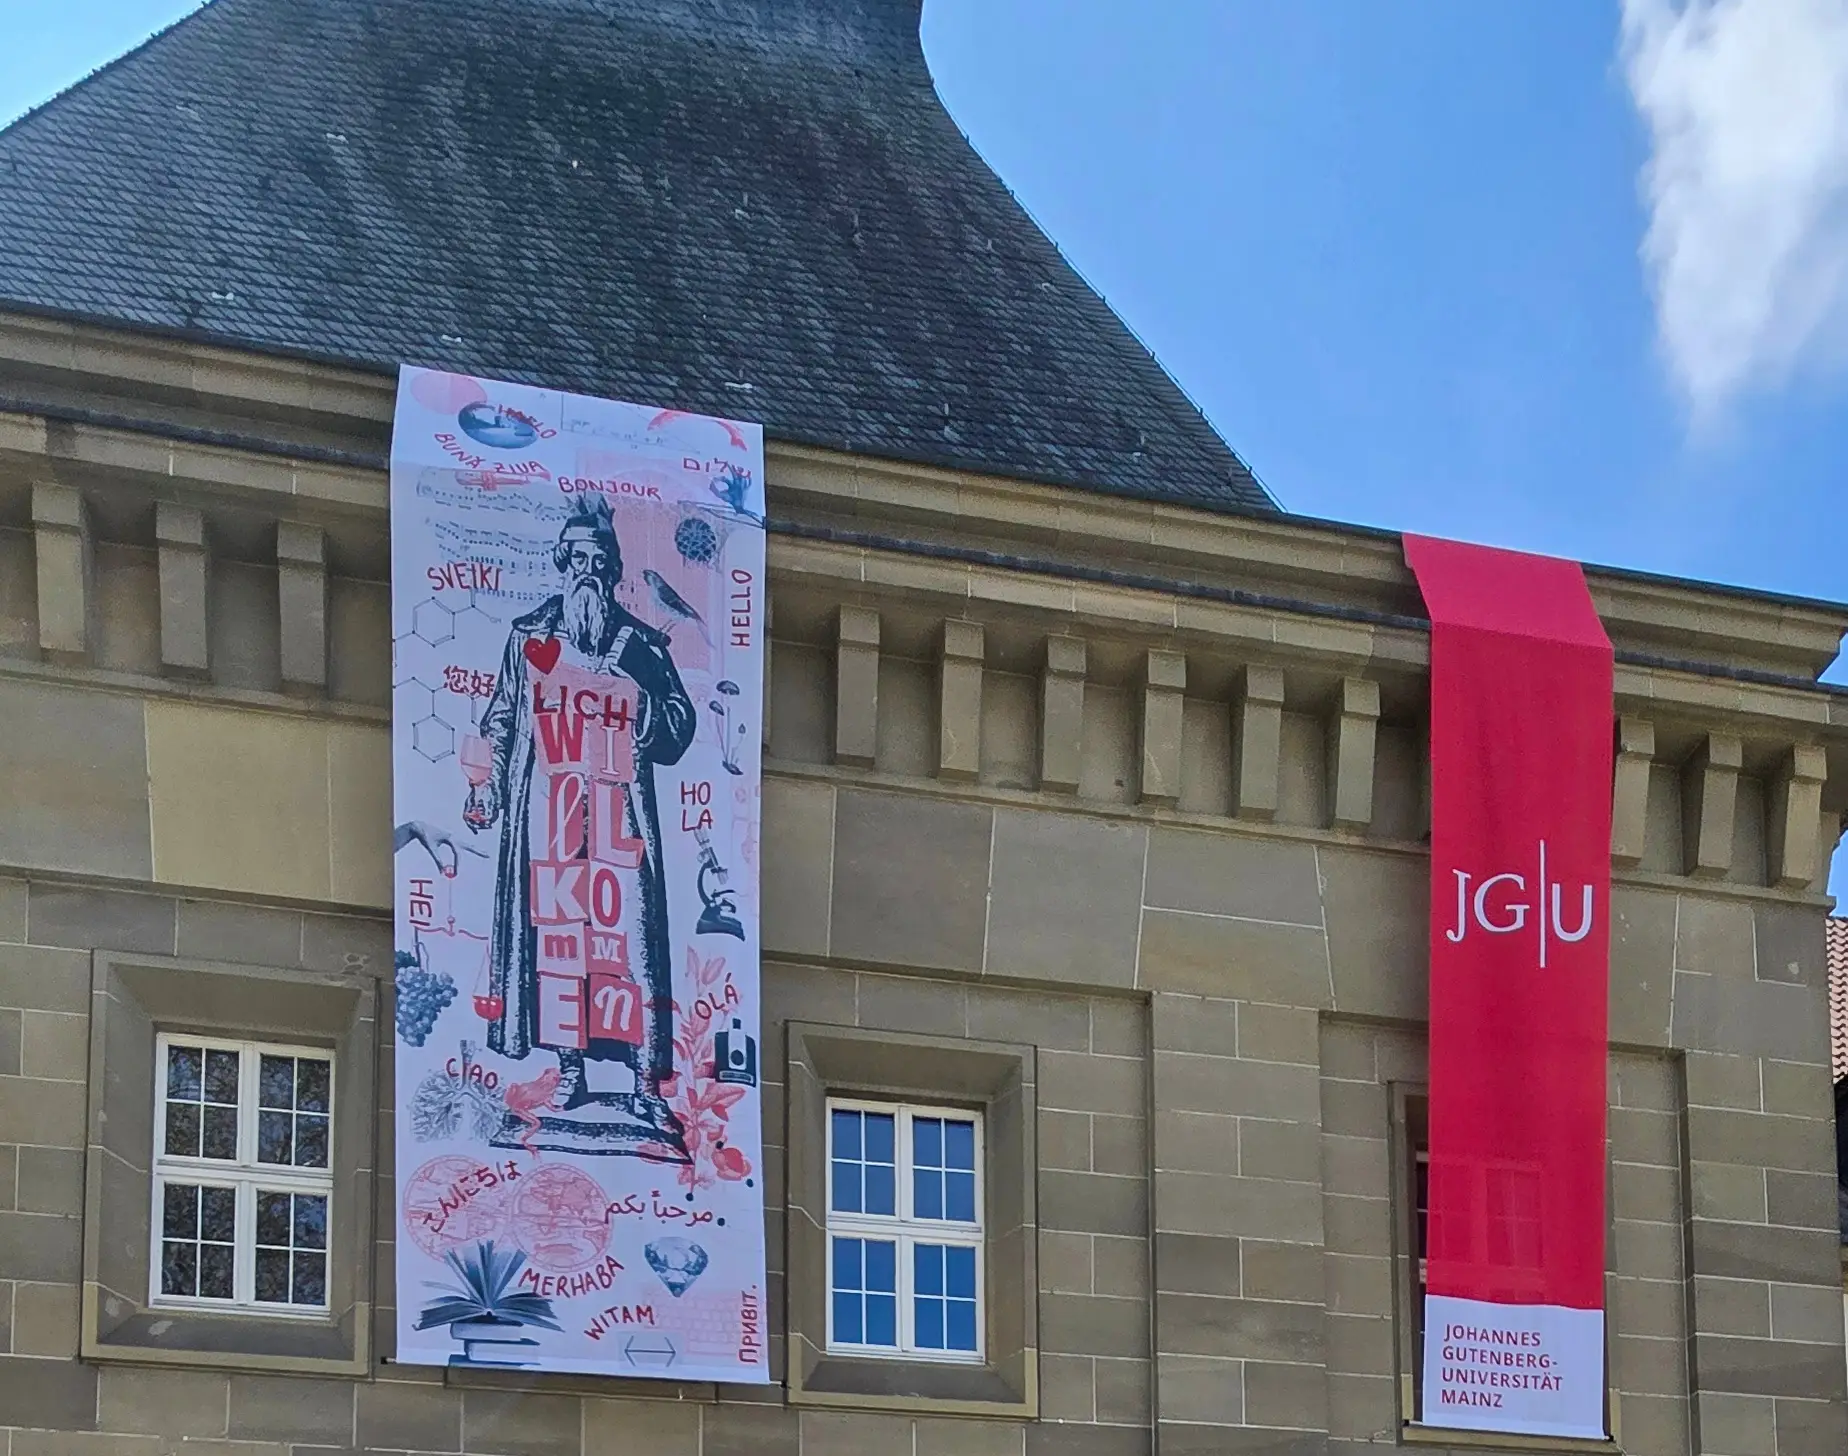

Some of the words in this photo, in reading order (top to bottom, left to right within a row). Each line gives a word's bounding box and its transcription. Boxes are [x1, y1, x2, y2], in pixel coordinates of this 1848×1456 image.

[557, 475, 662, 500] BONJOUR
[426, 562, 503, 591] SVEIKI
[730, 569, 753, 647] HELLO
[443, 665, 496, 698] 您好
[533, 681, 628, 731] LICH
[409, 879, 433, 926] HEI
[695, 972, 738, 1020] OLÁ
[445, 1057, 498, 1090] CIAO
[423, 1160, 522, 1233] こんにちは
[604, 1194, 646, 1225] بكم
[518, 1255, 624, 1298] MERHABA
[583, 1304, 655, 1341] WITAM
[1443, 1324, 1542, 1347] JOHANNES
[1442, 1345, 1559, 1369] GUTENBERG-
[1441, 1366, 1563, 1391] UNIVERSITÄT
[1440, 1388, 1504, 1408] MAINZ
